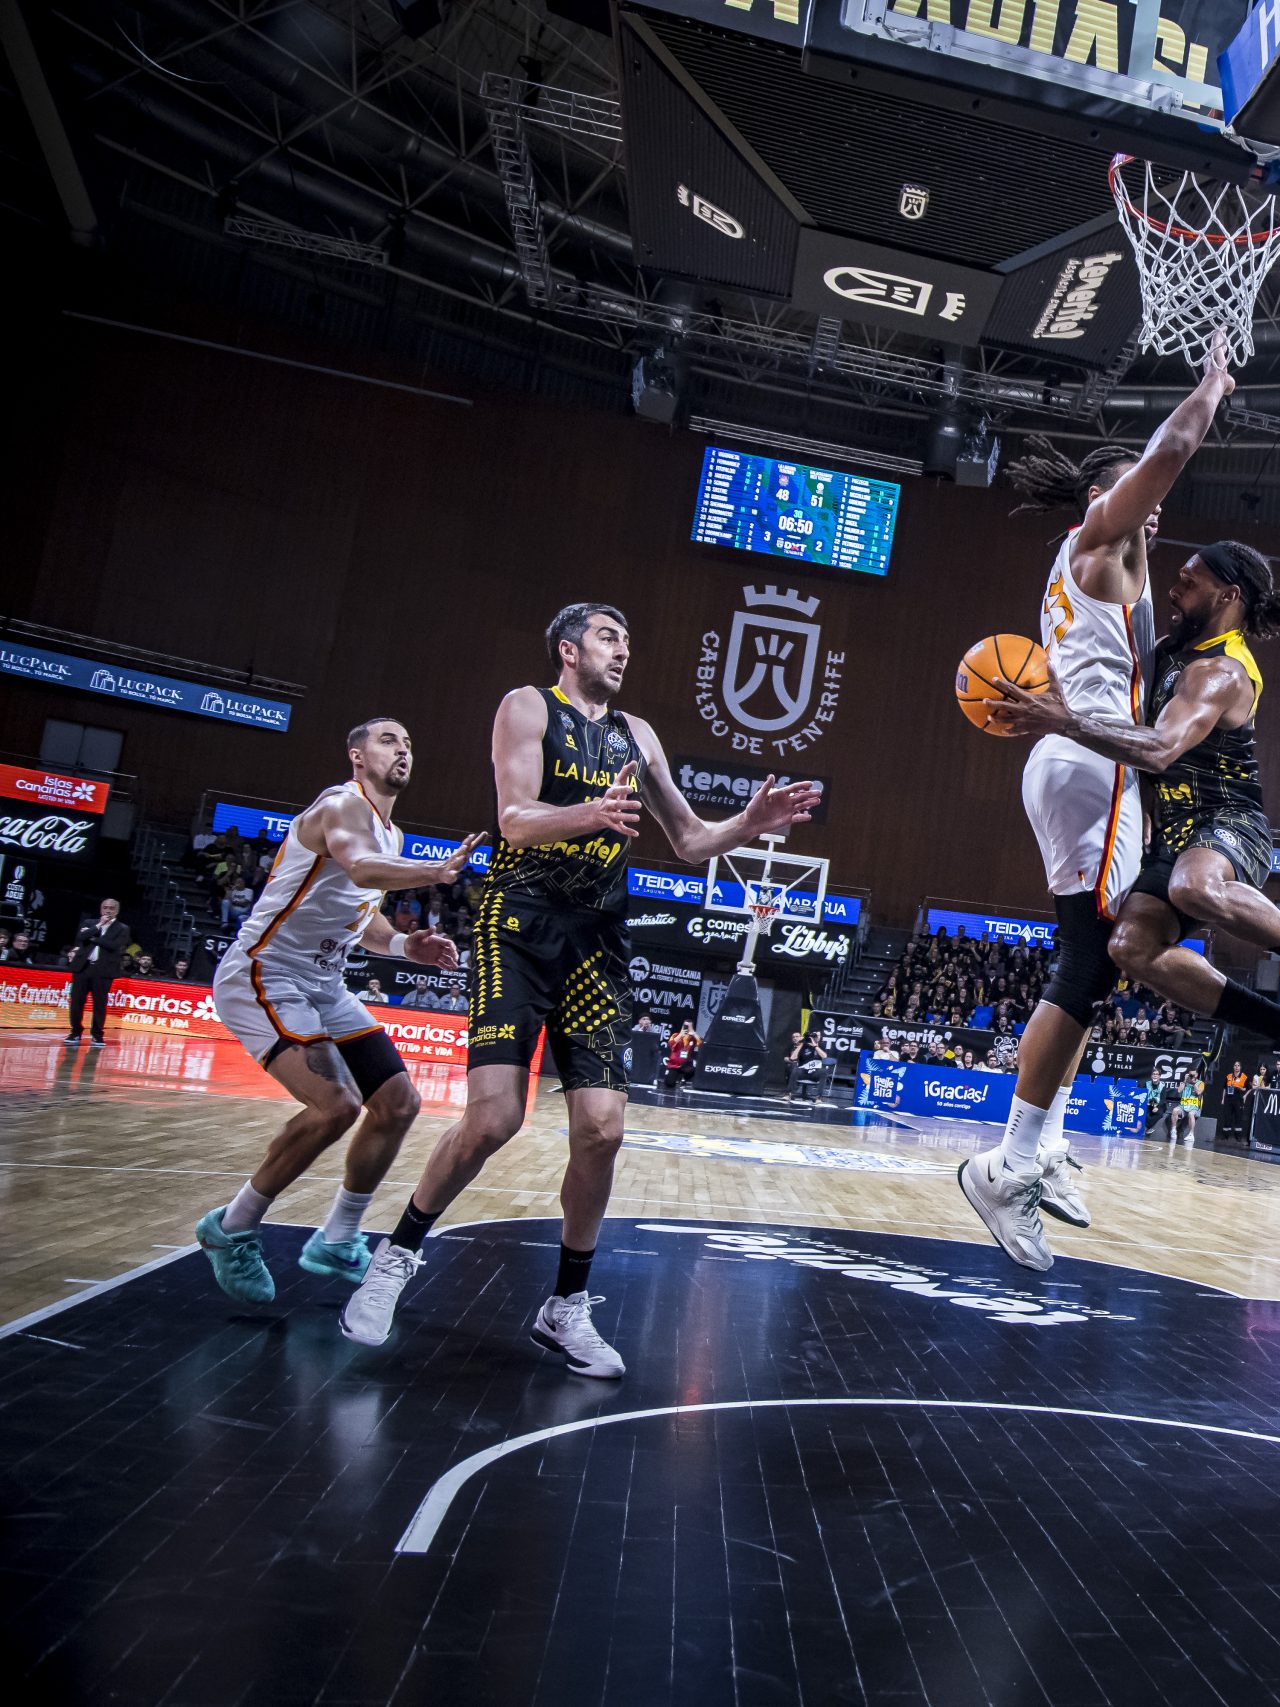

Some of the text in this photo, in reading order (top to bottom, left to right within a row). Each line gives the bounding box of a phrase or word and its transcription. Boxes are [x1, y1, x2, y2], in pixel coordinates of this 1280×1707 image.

[775, 489, 790, 501] 48
[810, 495, 823, 508] 51
[778, 516, 813, 535] 06:50
[764, 531, 771, 541] 3
[815, 541, 823, 552] 2
[695, 630, 845, 757] CABILDO DE TENERIFE
[555, 760, 579, 780] LA
[15, 779, 71, 798] Canarias
[44, 776, 73, 789] Islas
[771, 925, 850, 960] Libby's
[651, 964, 701, 980] TRANSVULCANIA
[395, 971, 467, 989] EXPRESS
[435, 1046, 452, 1057] VIDA
[822, 1037, 860, 1052] TCL
[705, 1065, 742, 1076] EXPRESS
